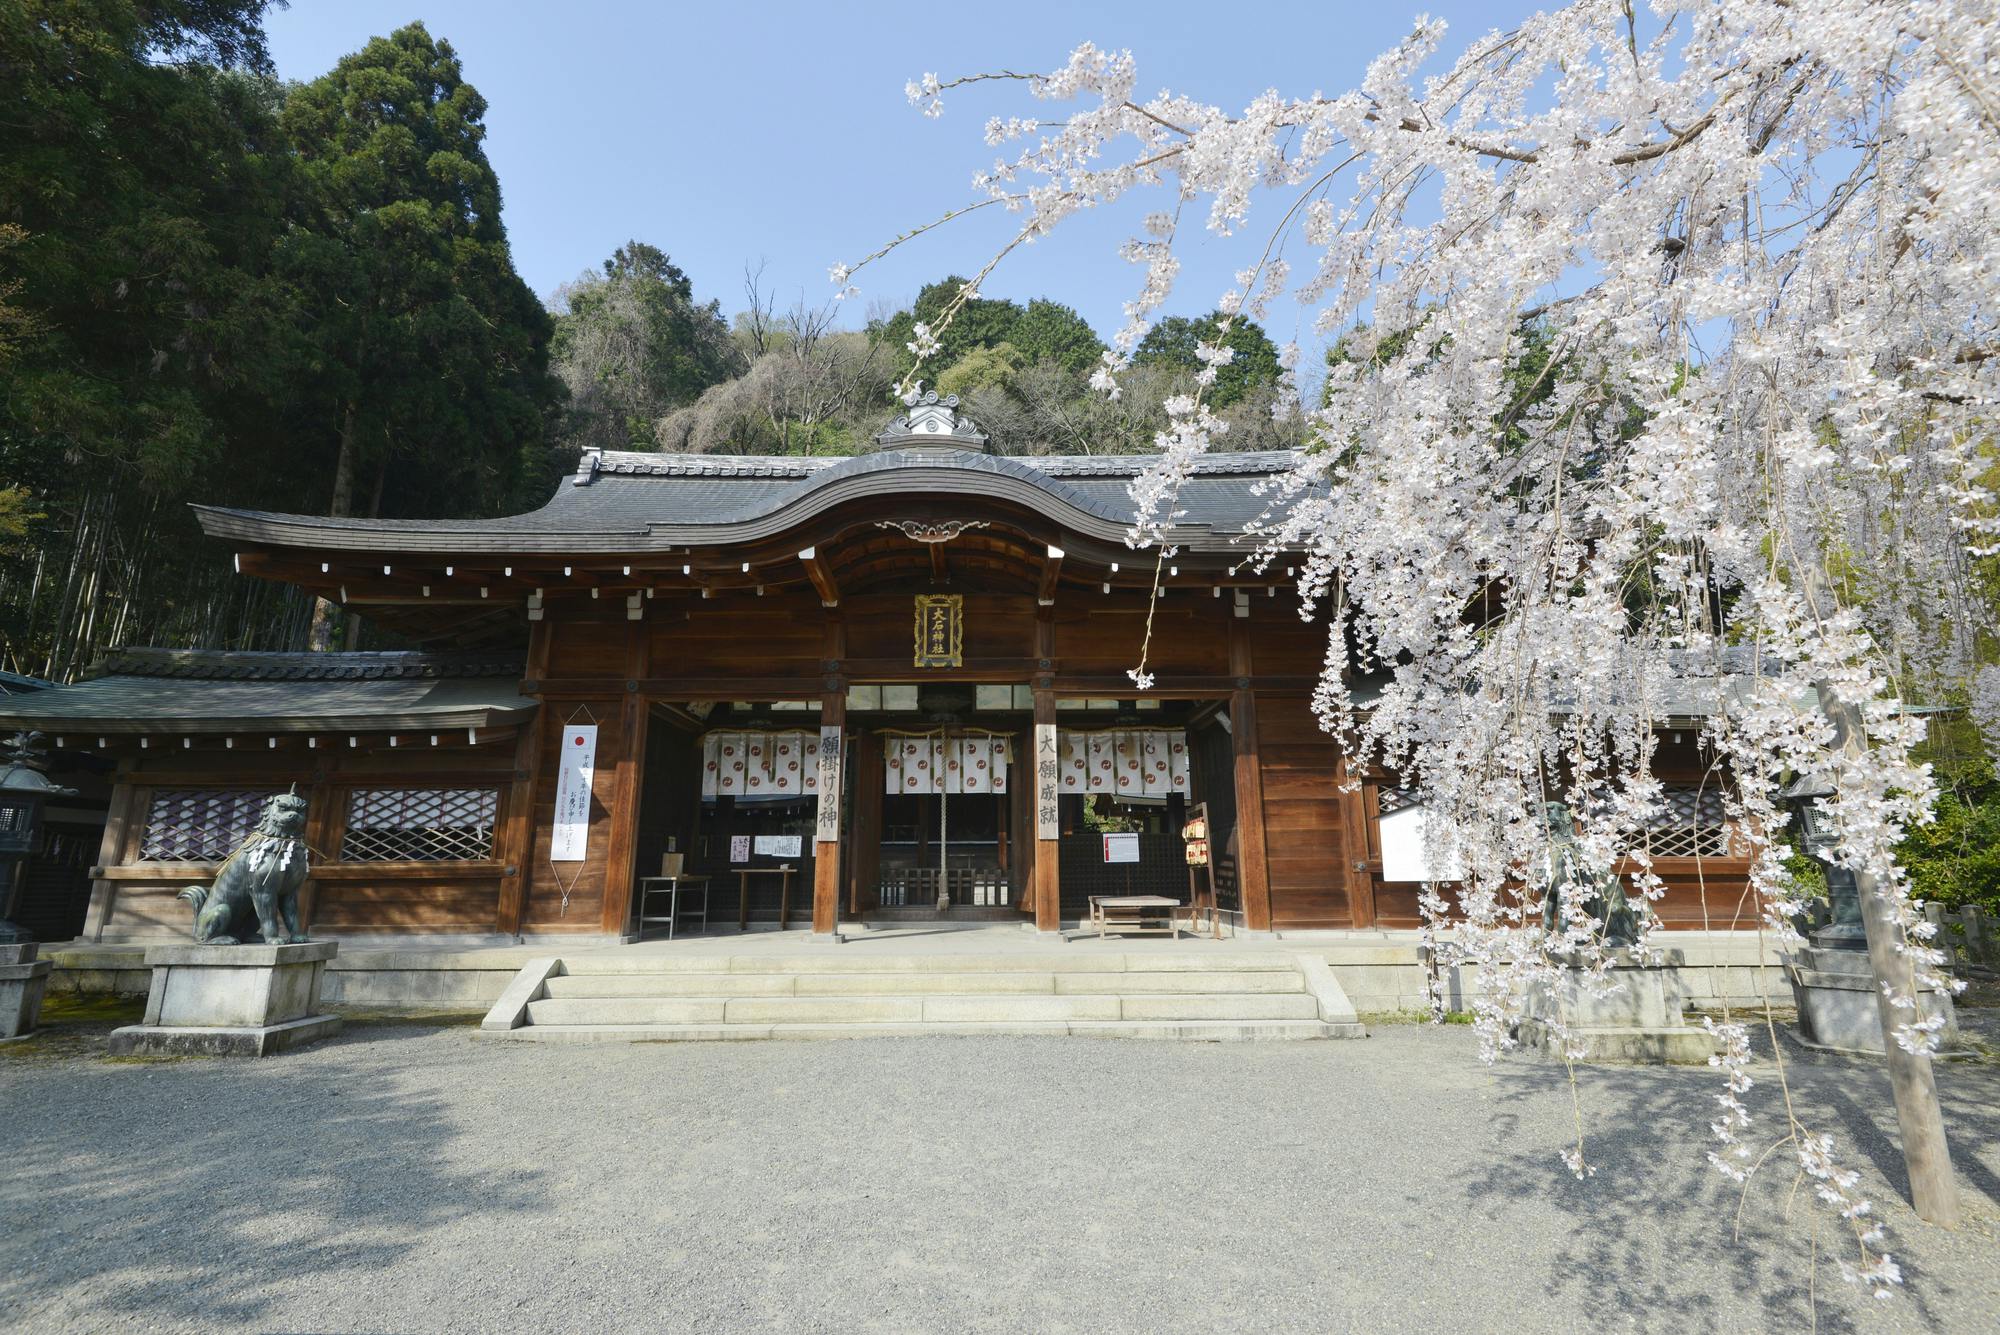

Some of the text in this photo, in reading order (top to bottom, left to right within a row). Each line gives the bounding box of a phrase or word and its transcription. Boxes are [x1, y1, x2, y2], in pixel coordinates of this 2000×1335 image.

[819, 736, 839, 828] 願掛けの神
[1038, 734, 1057, 825] 大願成就
